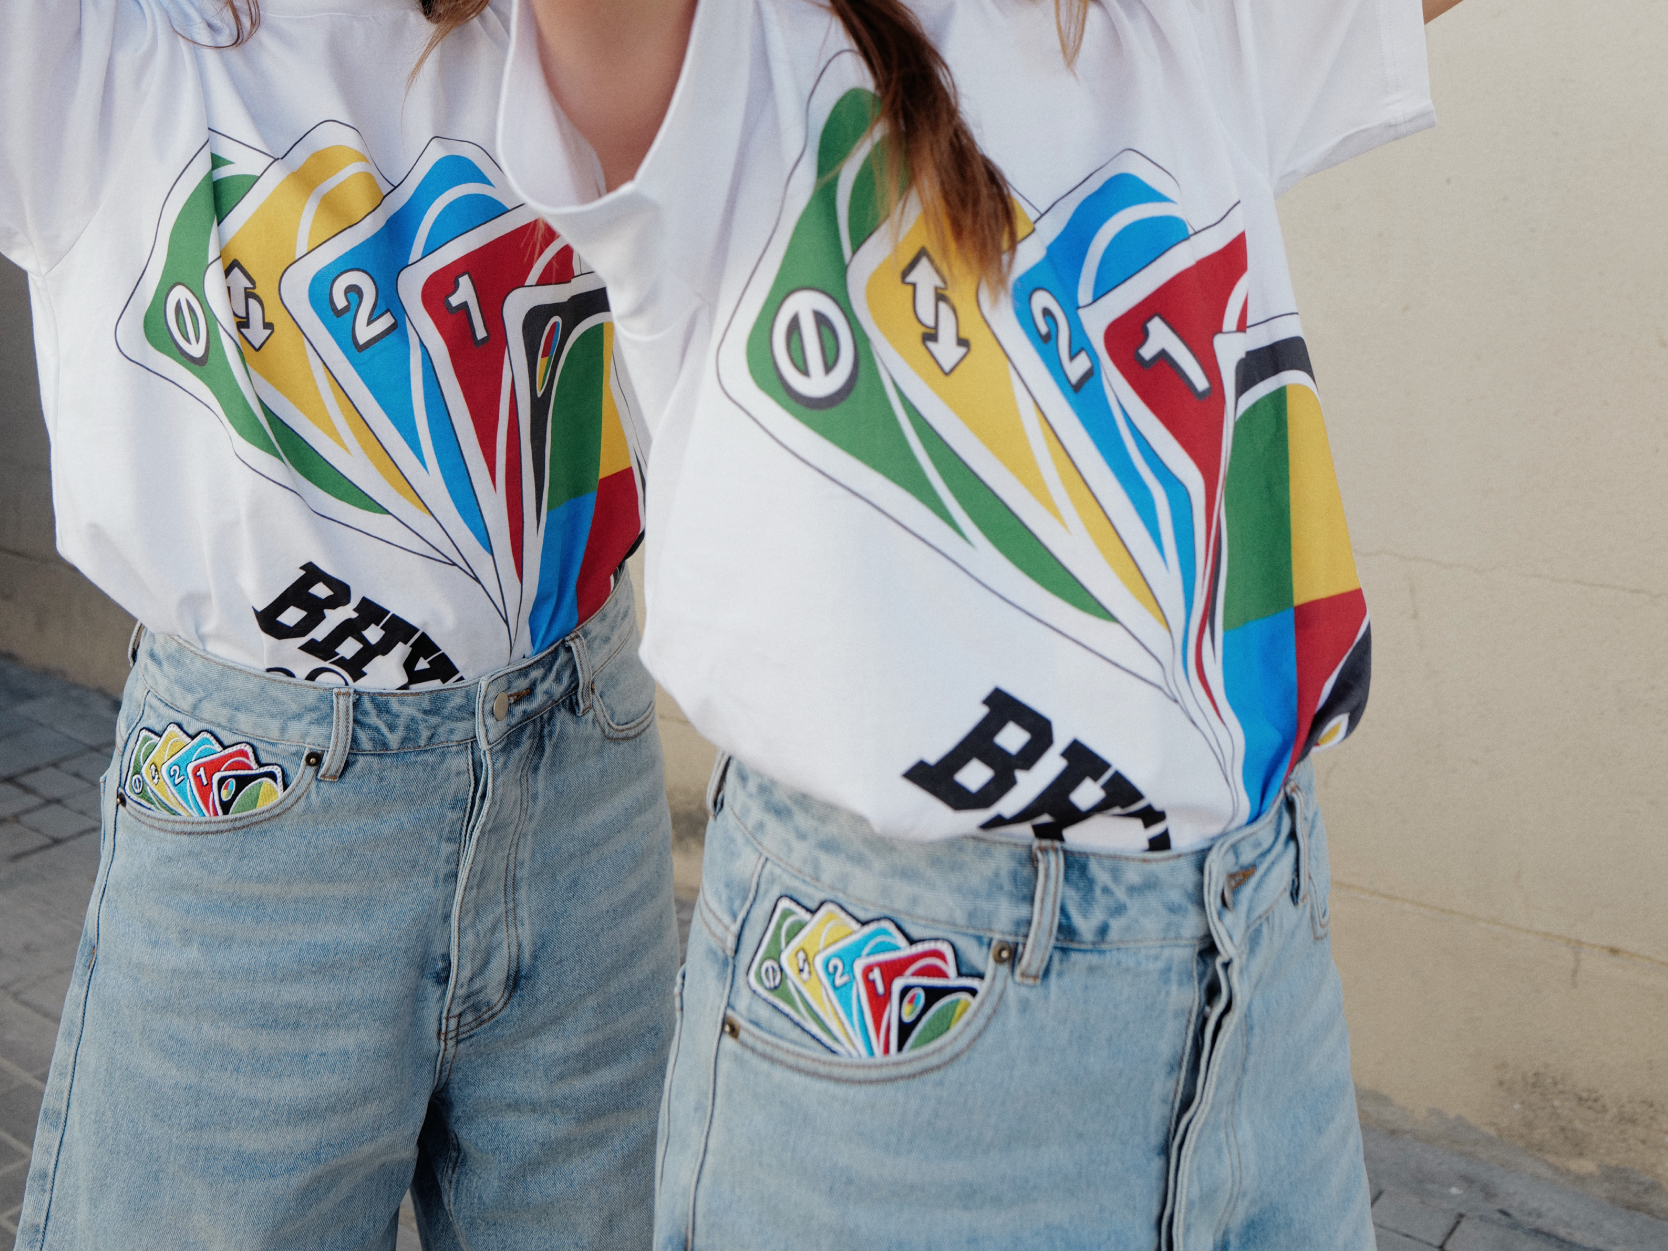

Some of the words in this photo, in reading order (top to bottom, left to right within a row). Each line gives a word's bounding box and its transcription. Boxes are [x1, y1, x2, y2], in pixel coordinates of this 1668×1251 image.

[329, 268, 399, 352] 2
[443, 273, 491, 348] 1
[1029, 287, 1095, 394] 2
[1134, 314, 1214, 400] 1
[252, 561, 465, 690] BHY
[169, 765, 186, 786] 2
[196, 766, 209, 787] 1
[827, 957, 850, 988] 2
[868, 966, 886, 997] 1
